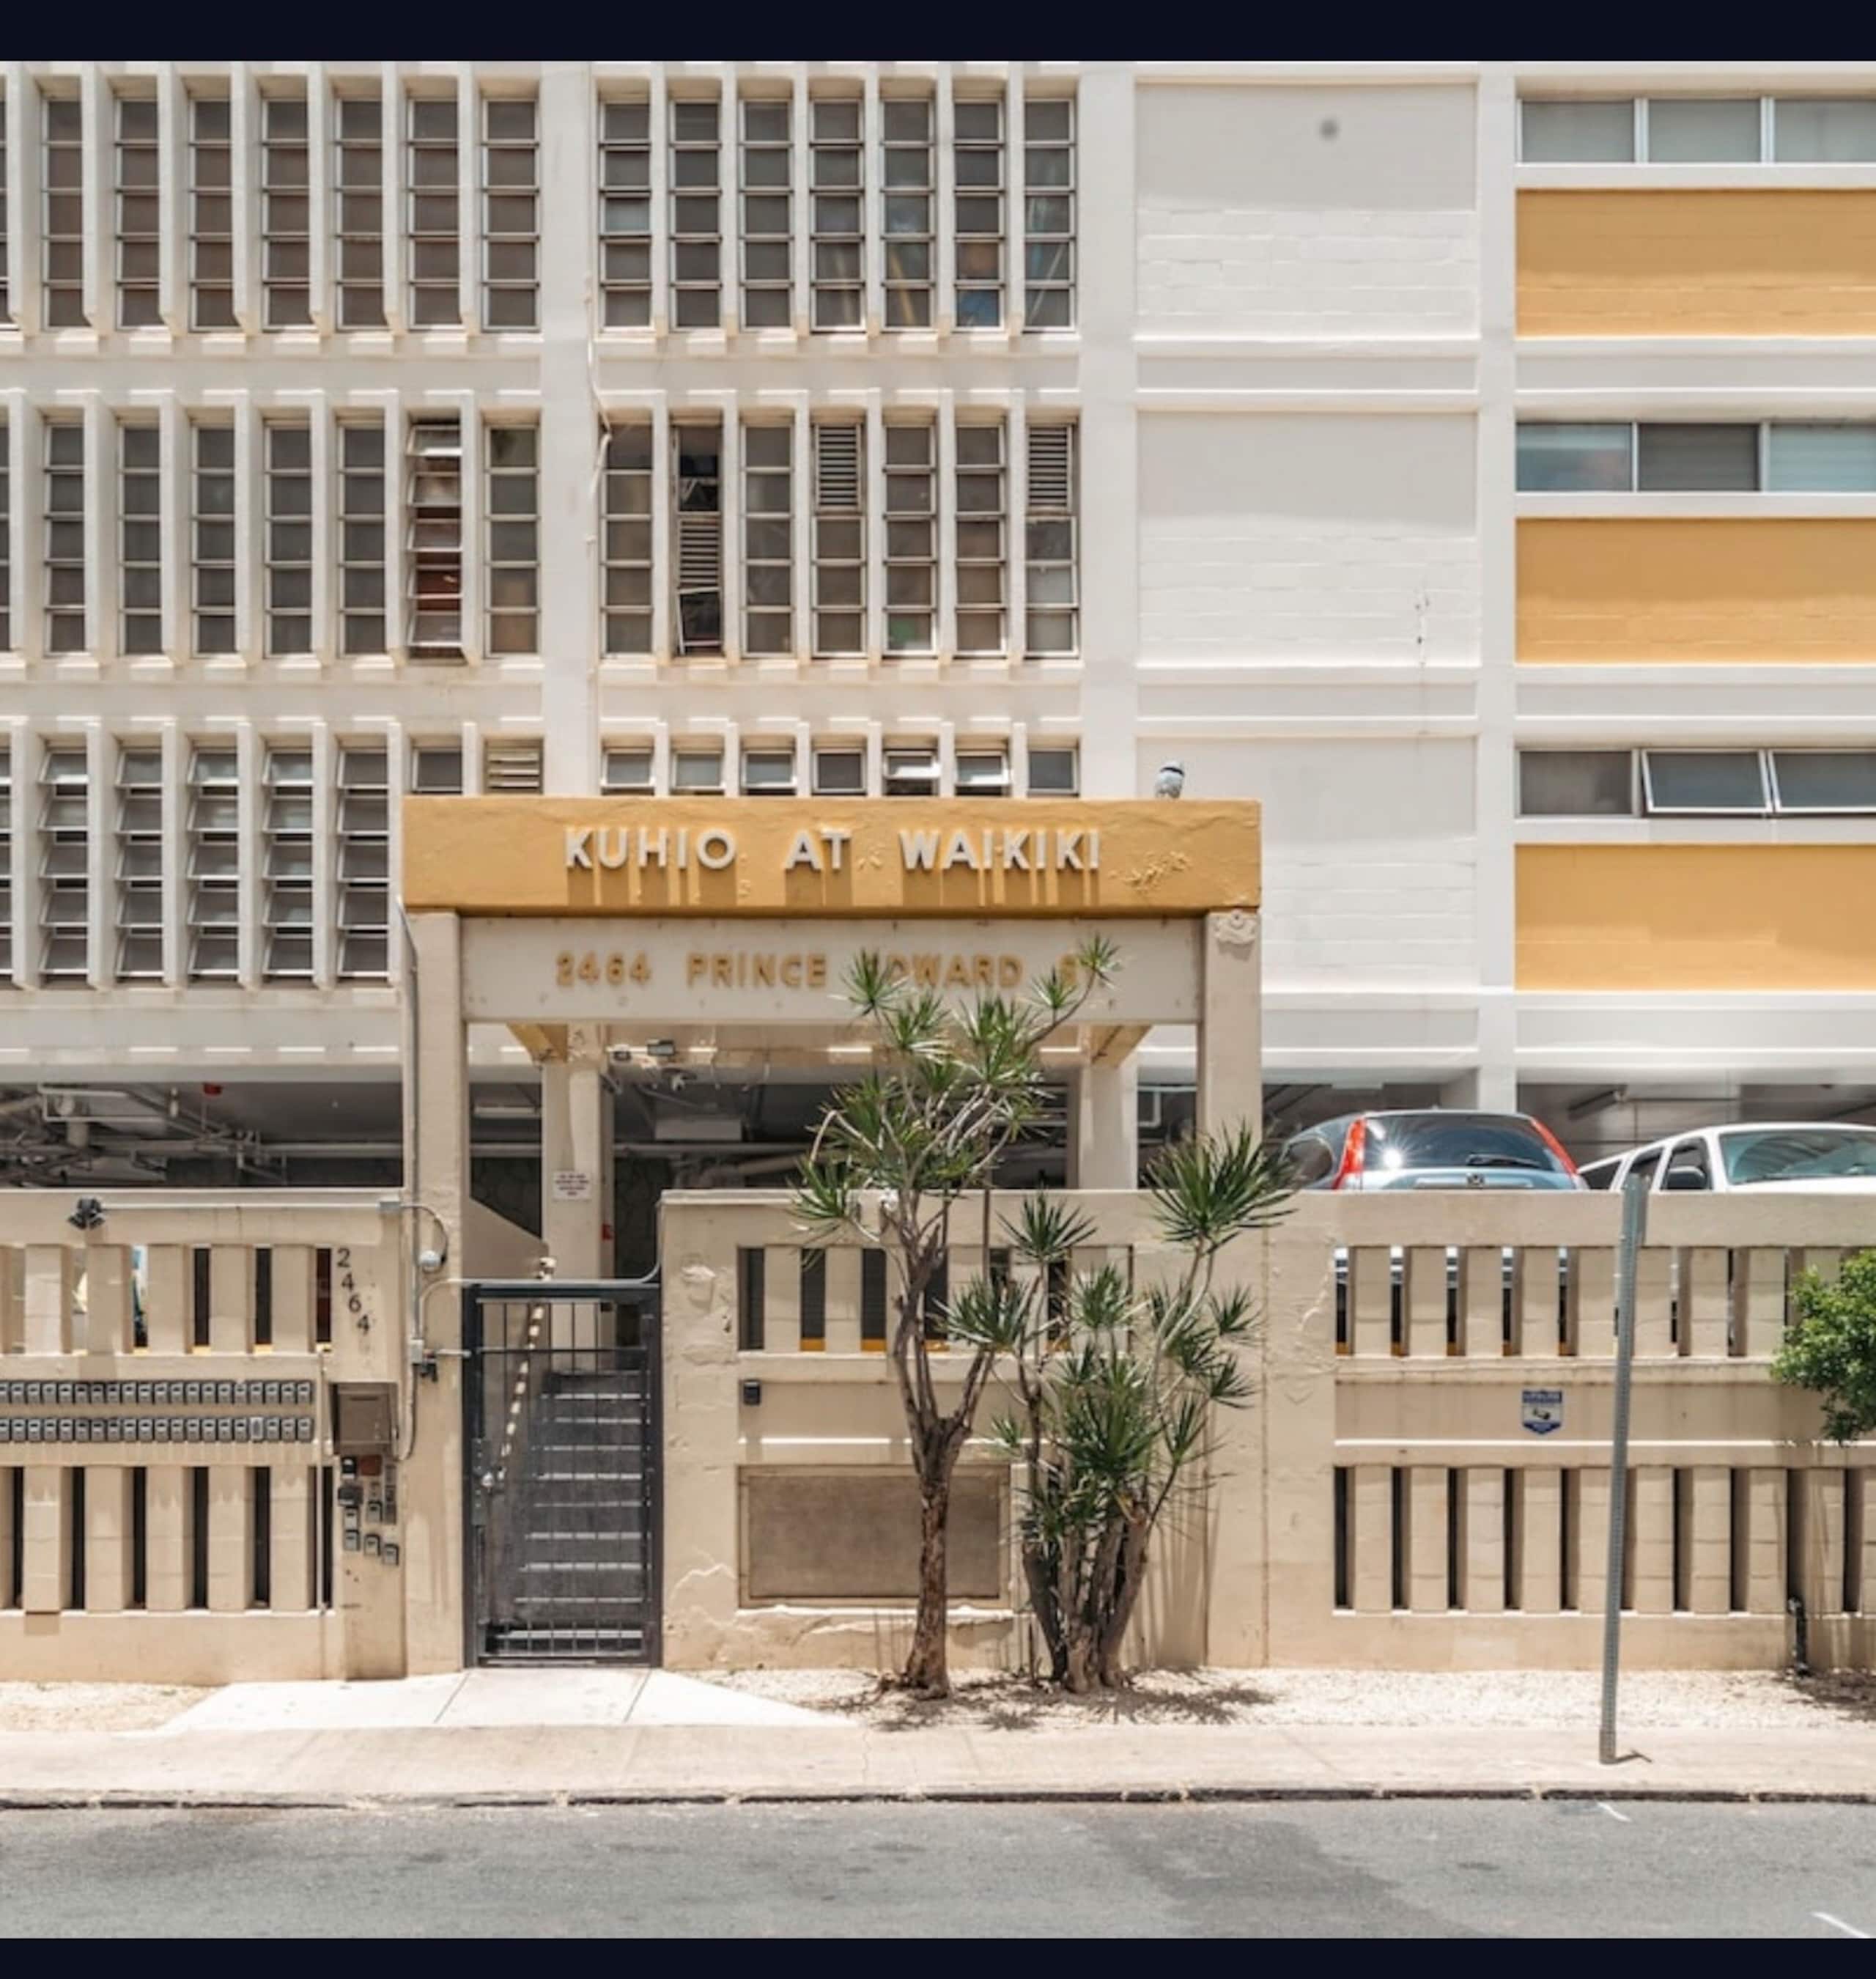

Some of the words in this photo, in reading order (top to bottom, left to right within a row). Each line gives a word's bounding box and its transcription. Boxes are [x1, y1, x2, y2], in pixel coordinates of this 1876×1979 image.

[565, 828, 737, 869] KUHIO
[782, 825, 852, 871] AT
[898, 828, 1101, 871] WAIKIKI
[555, 951, 652, 987] 2464
[687, 952, 827, 988] PRINCE
[860, 951, 1024, 988] DWARD
[336, 1245, 370, 1336] 2464
